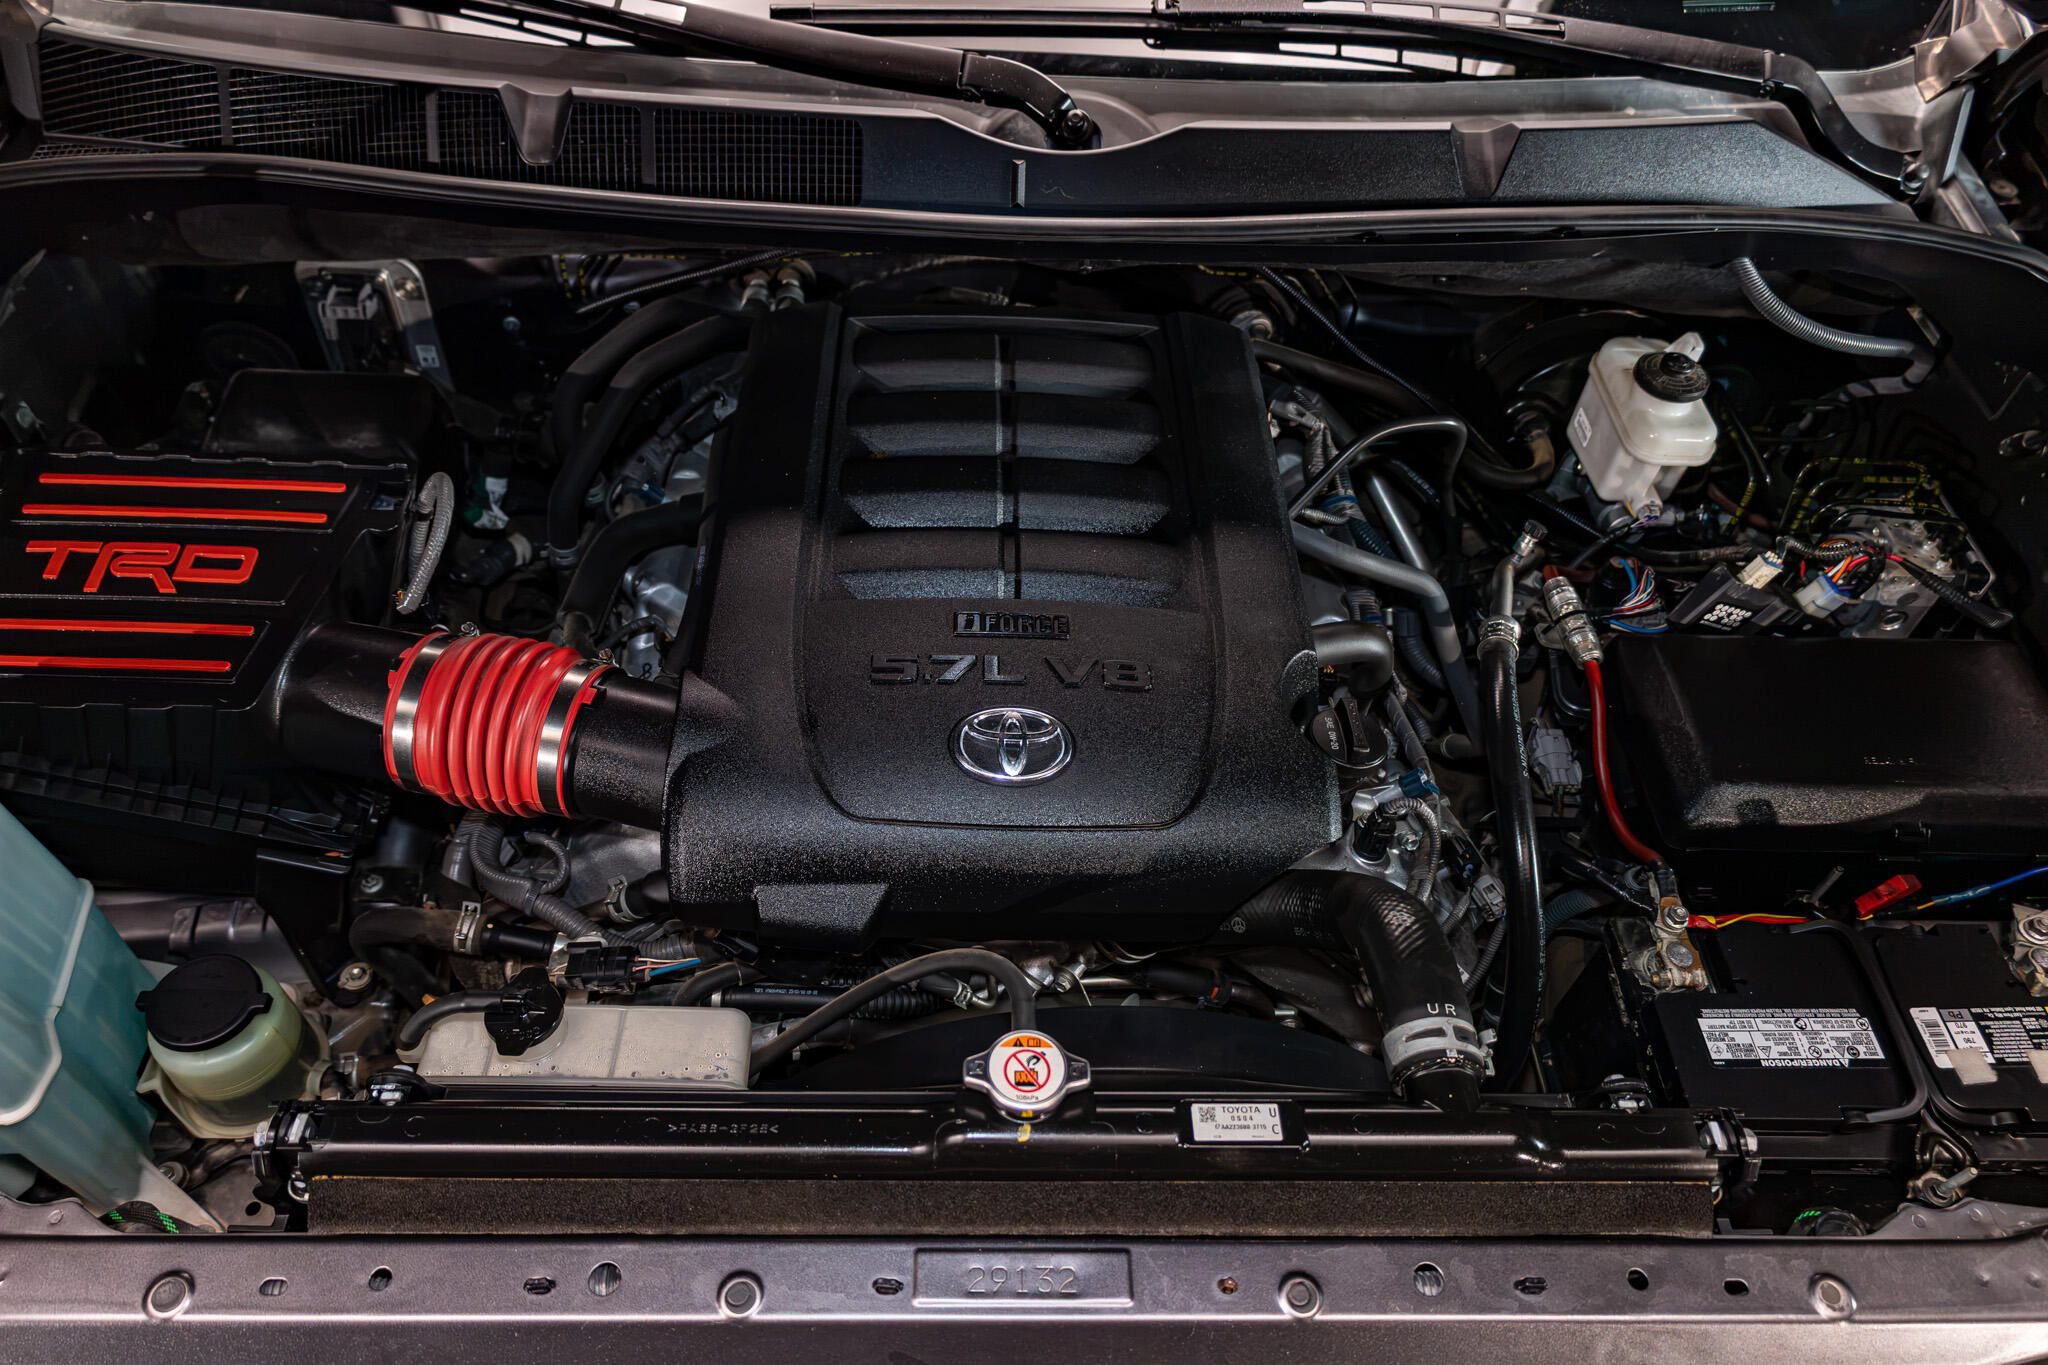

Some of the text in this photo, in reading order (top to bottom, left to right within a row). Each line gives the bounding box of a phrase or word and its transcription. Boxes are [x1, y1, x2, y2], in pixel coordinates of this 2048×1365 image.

[24, 539, 260, 594] TRD
[870, 653, 1152, 690] 5.7L V8
[1324, 717, 1340, 750] SAE 0W-20
[1948, 1011, 1963, 1019] Pb
[1760, 1058, 1840, 1067] DANGER/POISON
[1269, 1107, 1277, 1118] U
[1272, 1124, 1280, 1135] C
[967, 1265, 1078, 1293] 29132
